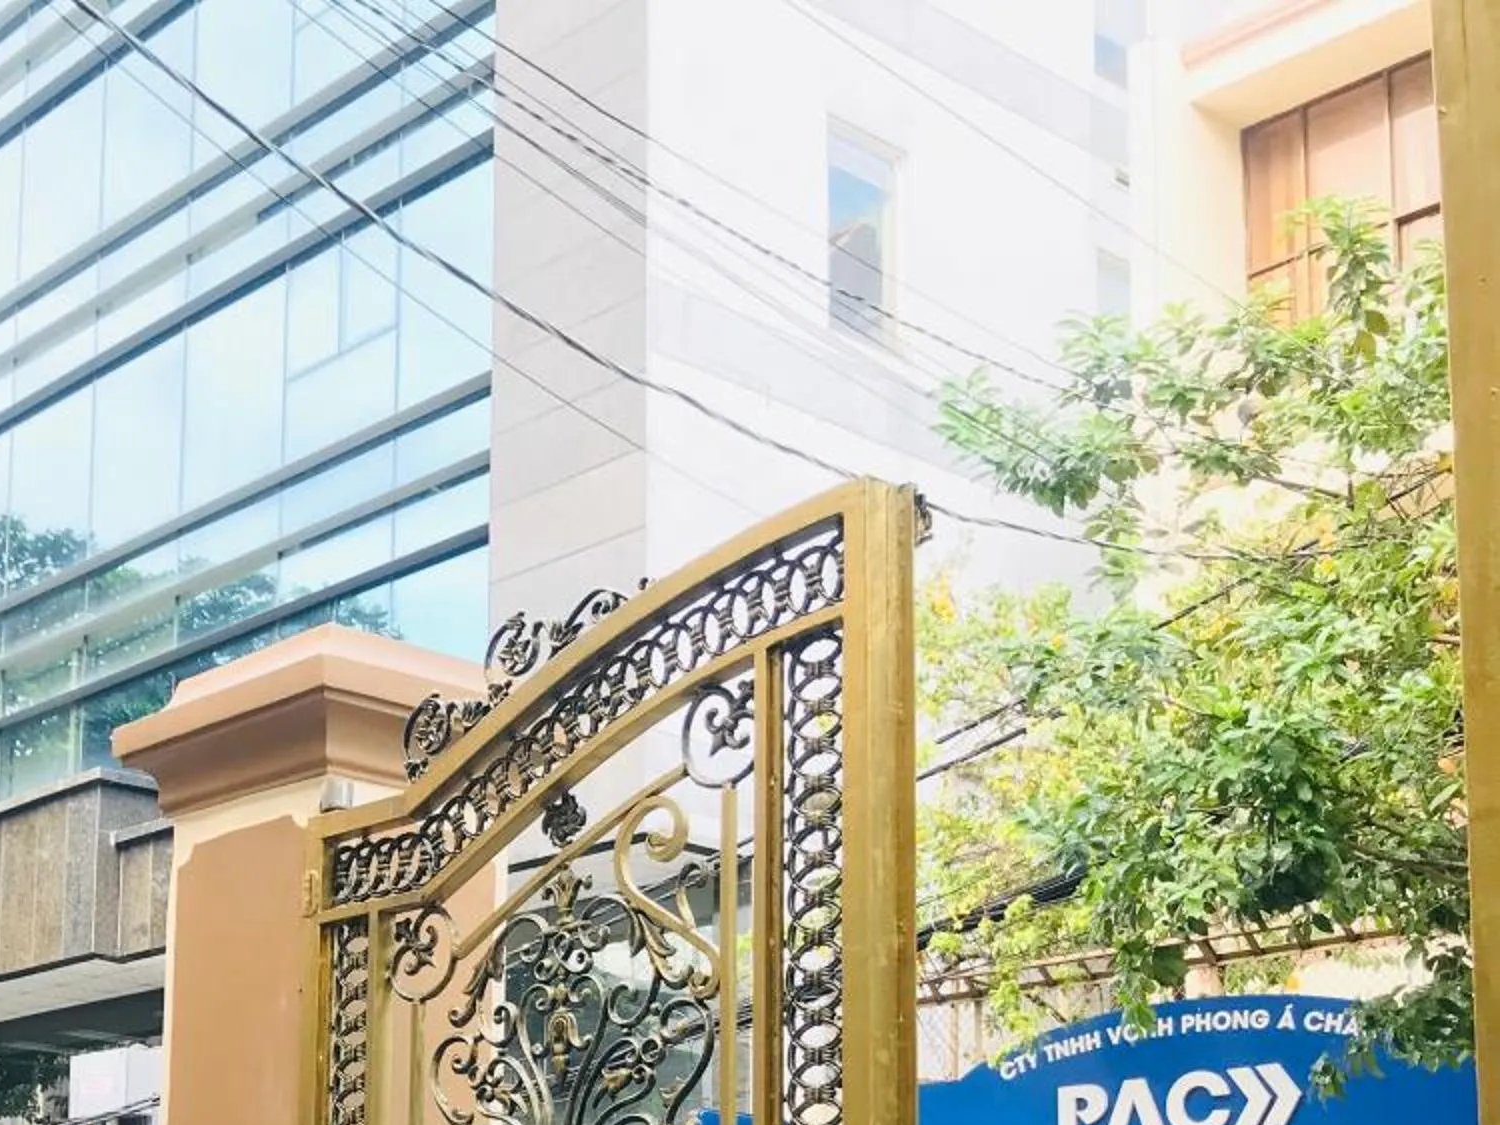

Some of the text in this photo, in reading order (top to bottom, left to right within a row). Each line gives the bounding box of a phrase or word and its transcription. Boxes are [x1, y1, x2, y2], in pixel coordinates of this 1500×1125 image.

[999, 1052, 1037, 1081] CTY
[1043, 1031, 1100, 1063] TNHH
[1181, 1008, 1270, 1035] PHONG
